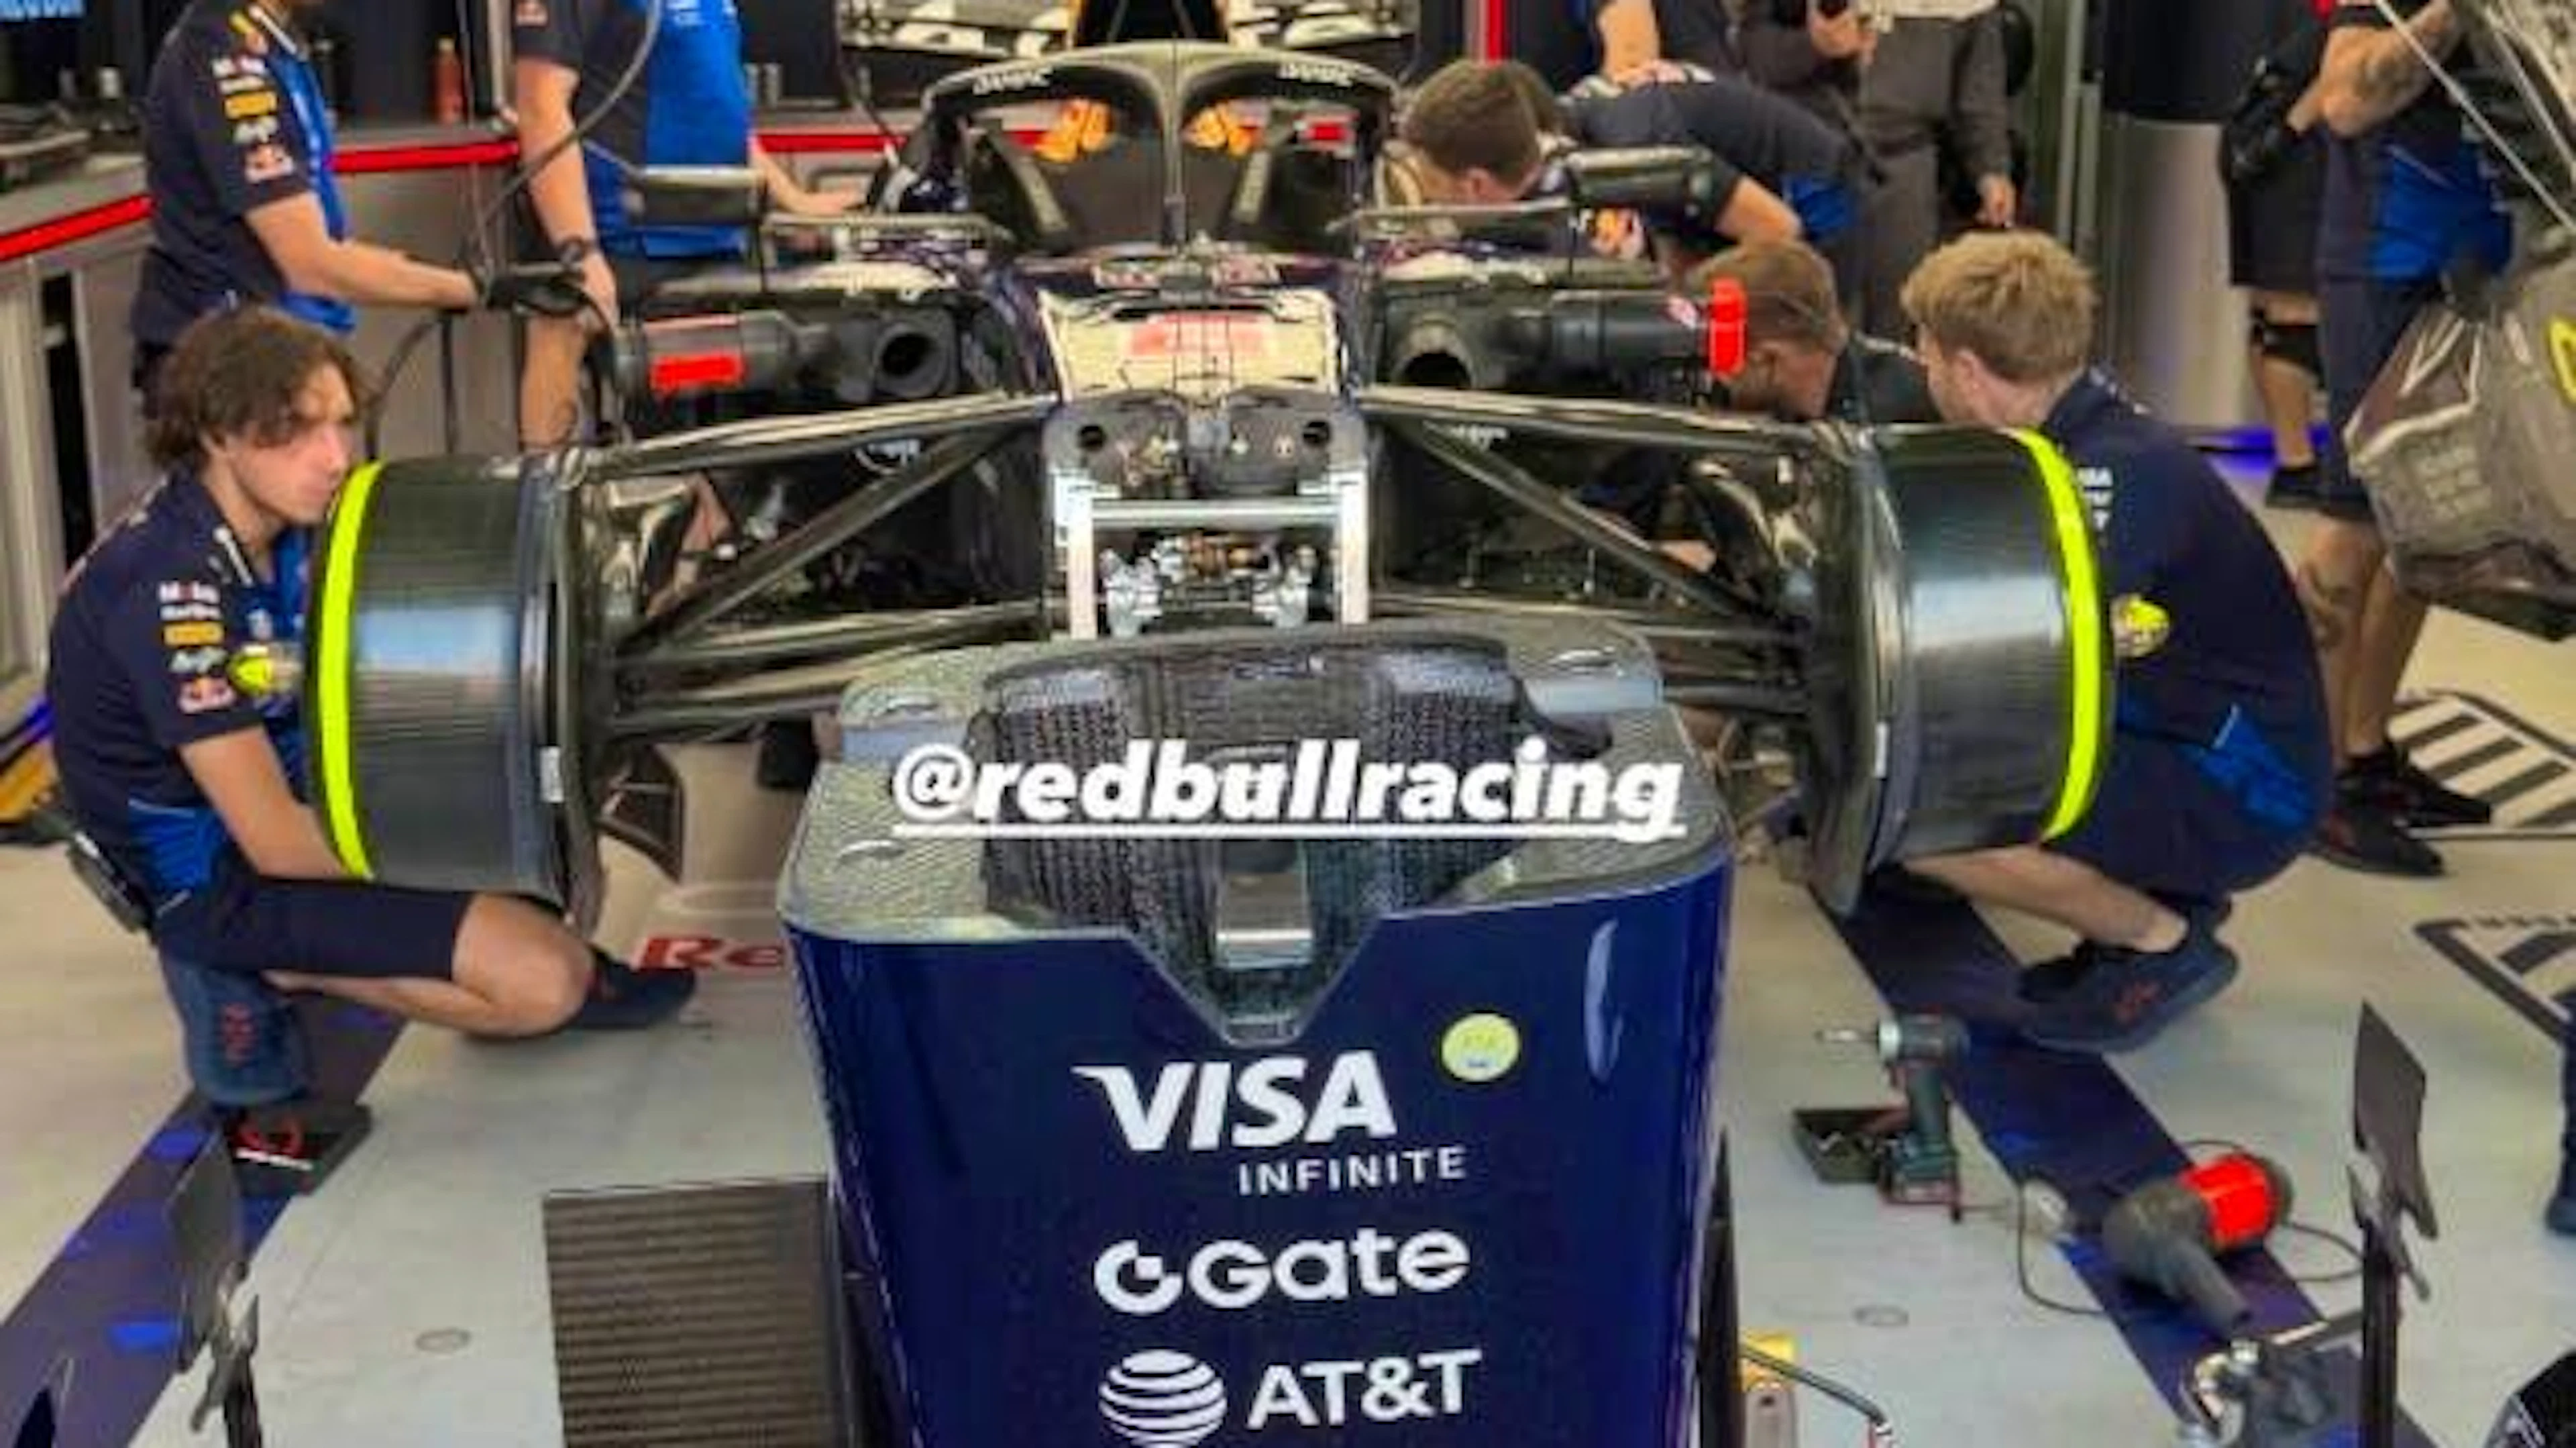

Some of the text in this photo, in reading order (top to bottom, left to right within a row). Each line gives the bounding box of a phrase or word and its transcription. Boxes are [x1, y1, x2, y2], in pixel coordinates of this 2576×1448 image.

[1073, 1049, 1398, 1151] VISA
[1238, 1146, 1468, 1196] INFINITE
[1188, 1228, 1470, 1309] Gate
[1248, 1349, 1483, 1429] AT&T
